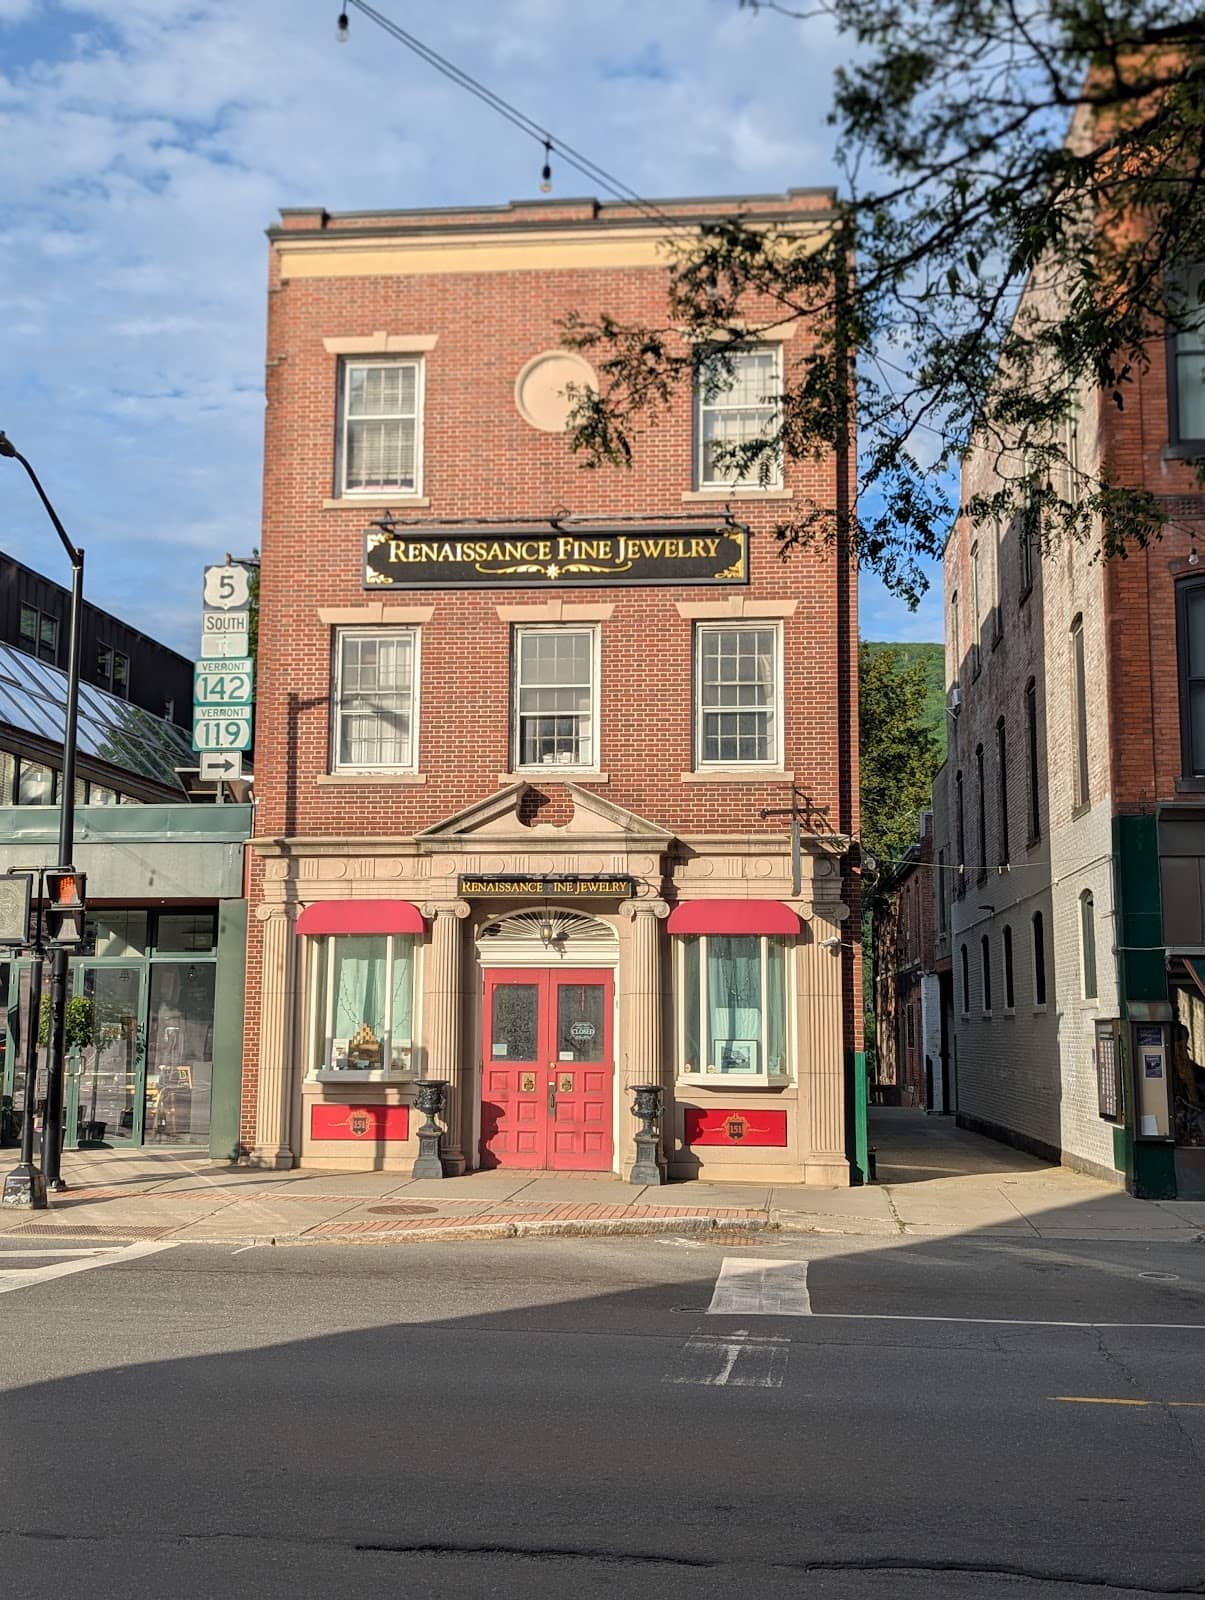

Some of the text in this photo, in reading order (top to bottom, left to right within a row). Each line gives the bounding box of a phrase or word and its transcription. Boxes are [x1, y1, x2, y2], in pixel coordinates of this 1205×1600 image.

[388, 536, 720, 564] RENAISSANCE FINE JEWELRY
[219, 575, 235, 599] 5
[206, 615, 245, 631] SOUTH
[202, 662, 246, 672] VERMONT
[201, 675, 245, 701] 142
[200, 708, 245, 718] VERMONT
[203, 721, 241, 747] 119
[462, 881, 544, 893] RENAISSANCE
[574, 881, 627, 895] JEWELRY
